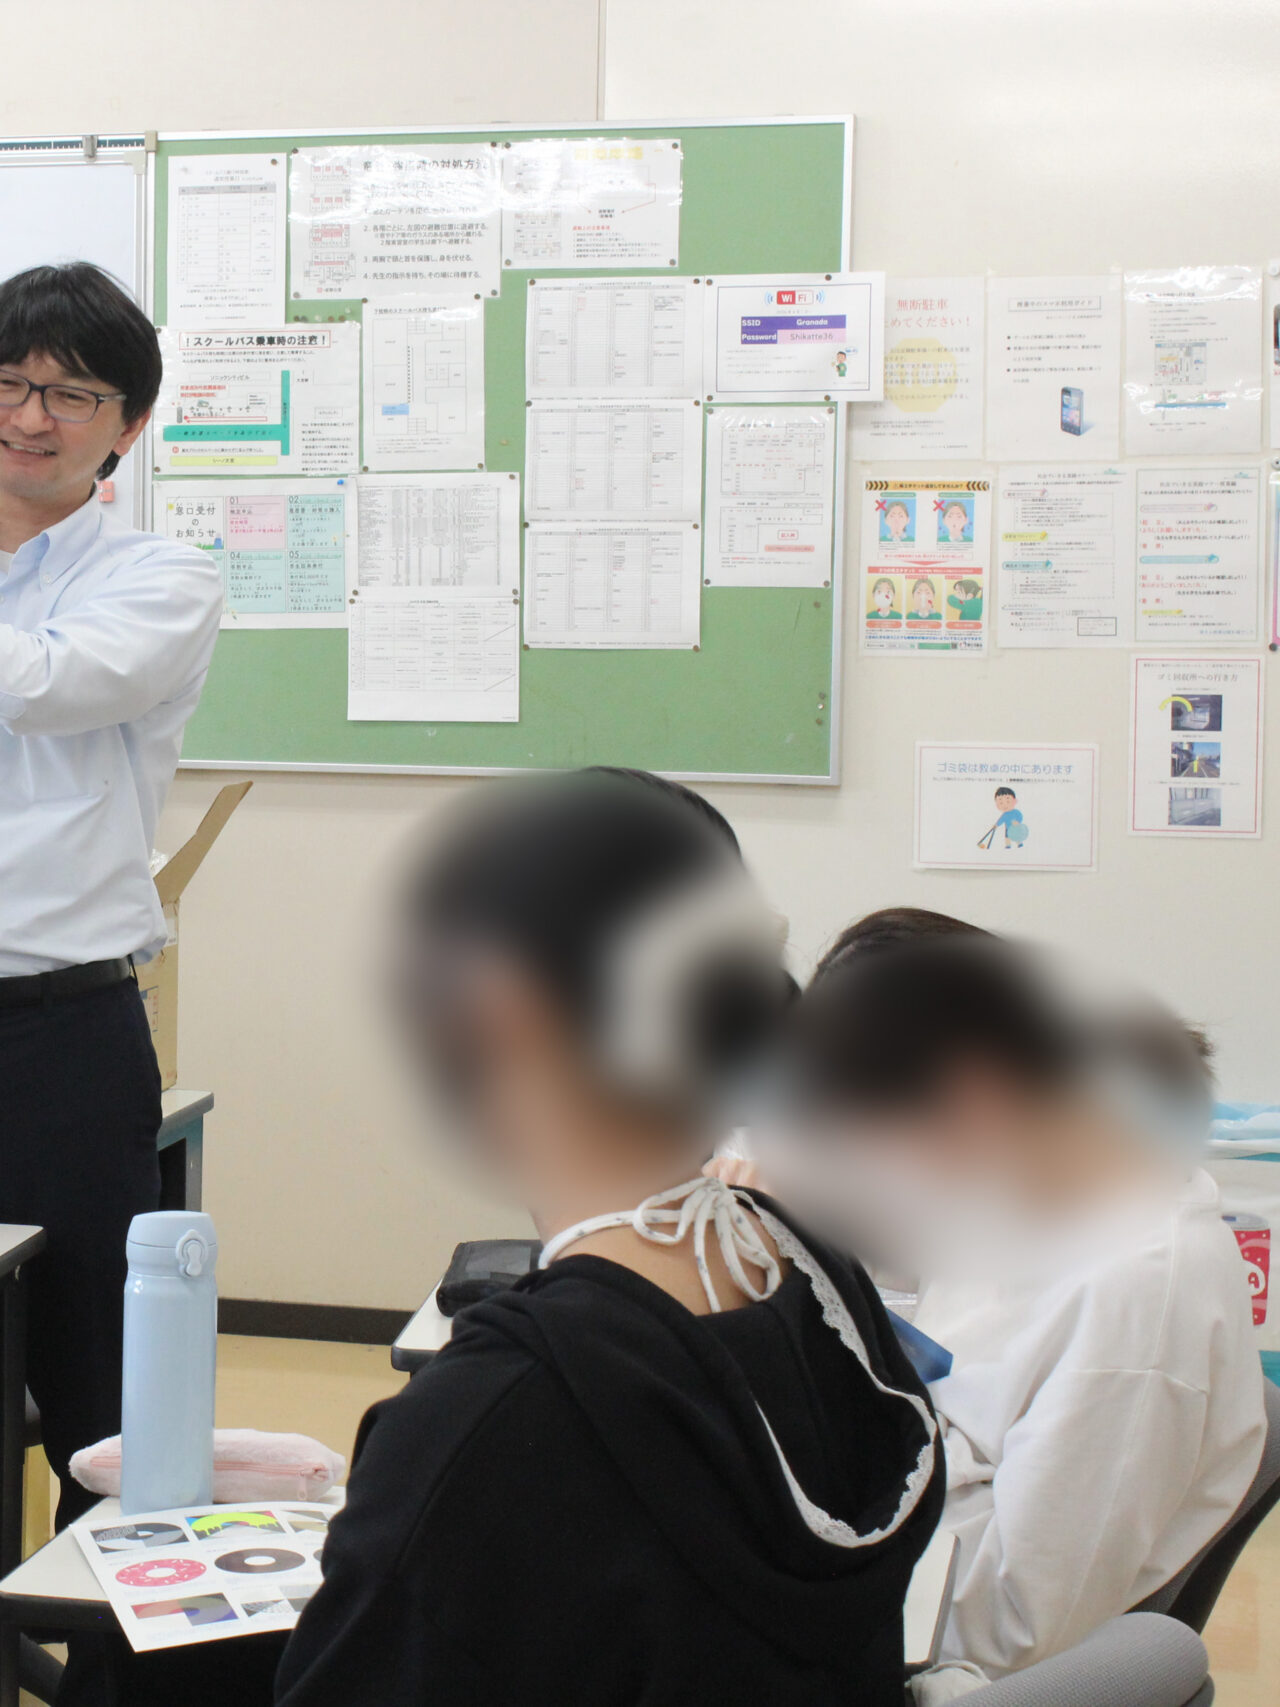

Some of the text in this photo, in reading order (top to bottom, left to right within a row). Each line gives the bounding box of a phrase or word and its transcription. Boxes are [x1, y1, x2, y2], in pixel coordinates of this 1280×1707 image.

[742, 318, 828, 327] SSID Granada
[741, 332, 777, 341] Password
